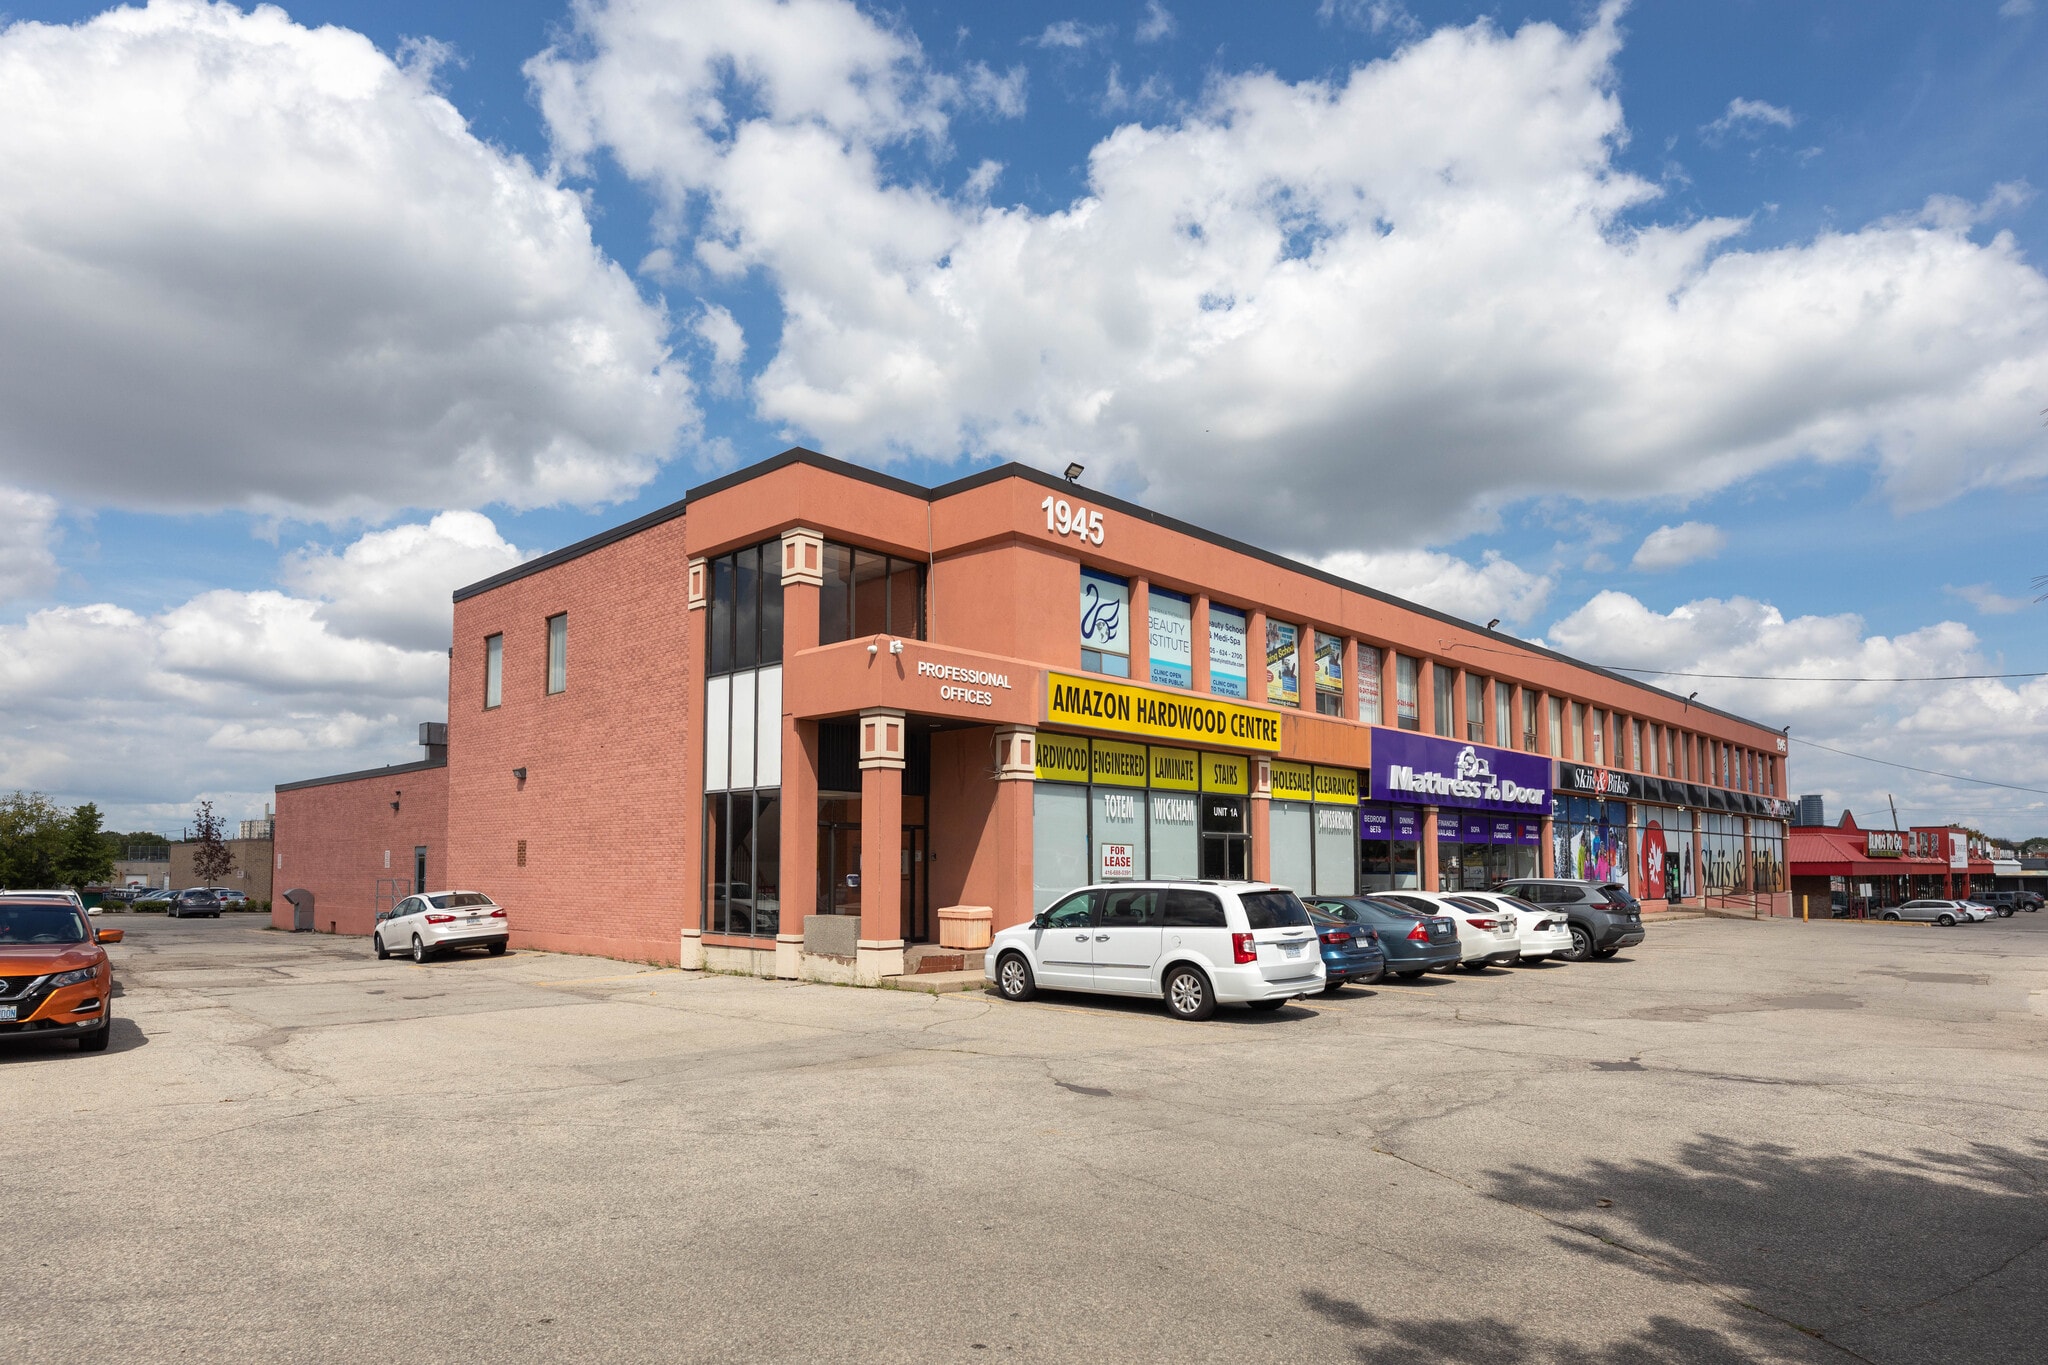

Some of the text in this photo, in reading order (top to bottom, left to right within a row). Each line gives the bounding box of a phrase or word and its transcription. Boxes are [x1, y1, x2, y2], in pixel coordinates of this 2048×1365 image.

[1041, 495, 1104, 545] 1945
[1149, 616, 1184, 635] BEAUTY
[1225, 623, 1244, 634] School
[1214, 632, 1240, 646] Medi-Spa
[1278, 644, 1295, 658] School
[918, 662, 1012, 688] PROFESSIONAL
[1154, 668, 1182, 679] CLINIC OPEN
[1159, 676, 1168, 684] THE
[1168, 678, 1184, 687] PUBLIC
[1212, 680, 1226, 688] CLINIC
[940, 685, 992, 706] OFFICES
[1218, 686, 1226, 694] THE
[1226, 688, 1240, 697] PUBLIC
[1053, 684, 1278, 742] AMAZON HARDWOOD CENTRE
[1094, 751, 1144, 776] ENGINEERED
[1155, 757, 1194, 781] LAMINATE
[1214, 764, 1238, 786] STAIRS
[1316, 776, 1354, 796] CLEARANCE
[1390, 764, 1482, 798] Mattress
[1482, 783, 1500, 800] To
[1502, 780, 1546, 804] Door
[1575, 768, 1630, 794] Skiis & Biikes
[1104, 795, 1194, 821] TOTEM WICKHAM
[1214, 807, 1238, 817] UNIT 1A
[1364, 814, 1386, 824] BEDROOM
[1400, 816, 1414, 825] DINING
[1438, 819, 1458, 828] FINANCING
[1370, 826, 1382, 834] SETS
[1402, 827, 1412, 835] SETS
[1110, 846, 1124, 855] FOR
[1104, 856, 1131, 867] LEASE
[1702, 849, 1731, 888] Skiis
[1734, 850, 1746, 887] &
